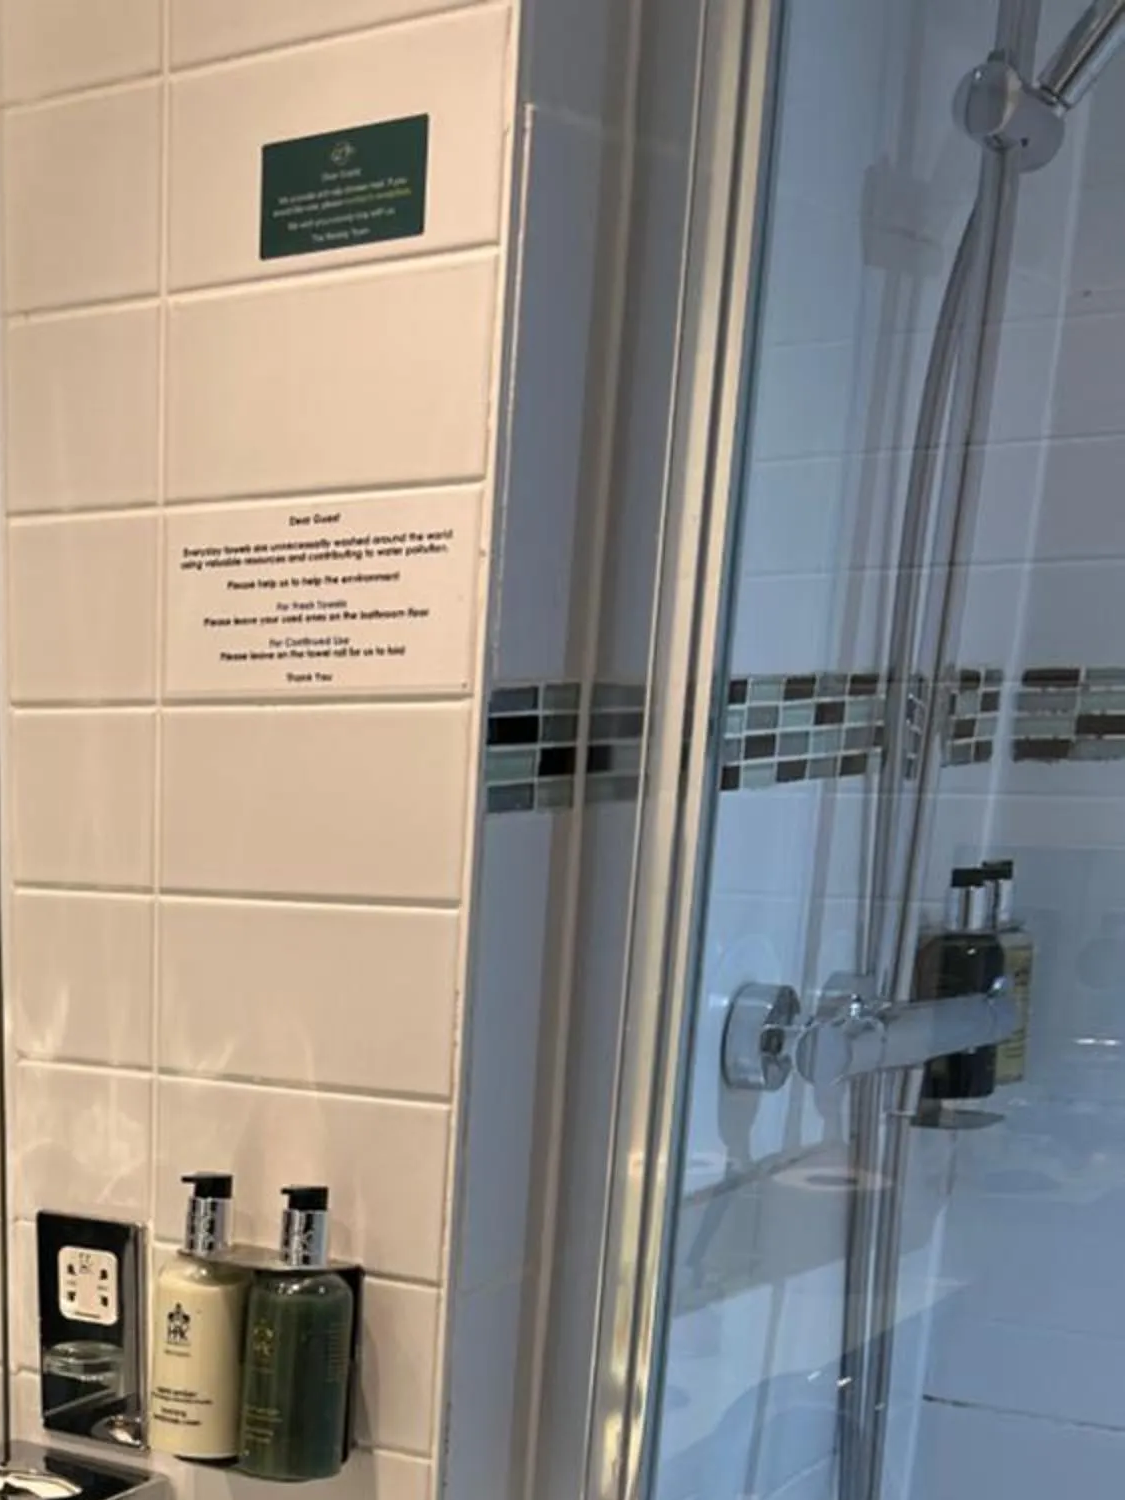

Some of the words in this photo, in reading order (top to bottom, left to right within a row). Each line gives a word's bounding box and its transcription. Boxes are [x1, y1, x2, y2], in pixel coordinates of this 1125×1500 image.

[289, 515, 310, 526] Dear
[313, 513, 341, 524] Guest
[334, 534, 371, 546] washed
[372, 533, 406, 545] around
[408, 531, 424, 541] the
[180, 561, 202, 571] using
[205, 558, 241, 568] valuable
[244, 555, 285, 565] resources
[288, 552, 306, 562] and
[308, 549, 362, 561] contributing
[365, 548, 374, 558] to
[377, 547, 403, 557] water
[227, 580, 255, 590] Please
[257, 578, 276, 590] help
[279, 579, 289, 588] us
[291, 577, 300, 587] to
[302, 575, 321, 587] help
[324, 575, 338, 584] the
[203, 617, 231, 627] Please
[233, 615, 258, 626] leave
[259, 615, 279, 626] your
[281, 613, 303, 624] used
[305, 613, 326, 624] ones
[328, 612, 340, 622] on
[342, 610, 357, 620] the
[360, 608, 405, 620] bathroom
[407, 607, 429, 618] floor
[220, 651, 247, 661] Please
[249, 649, 274, 660] leave
[276, 650, 288, 660] on
[290, 648, 304, 658] the
[306, 648, 330, 659] towel
[362, 647, 374, 657] us
[375, 646, 385, 656] to
[285, 671, 312, 682] Thank
